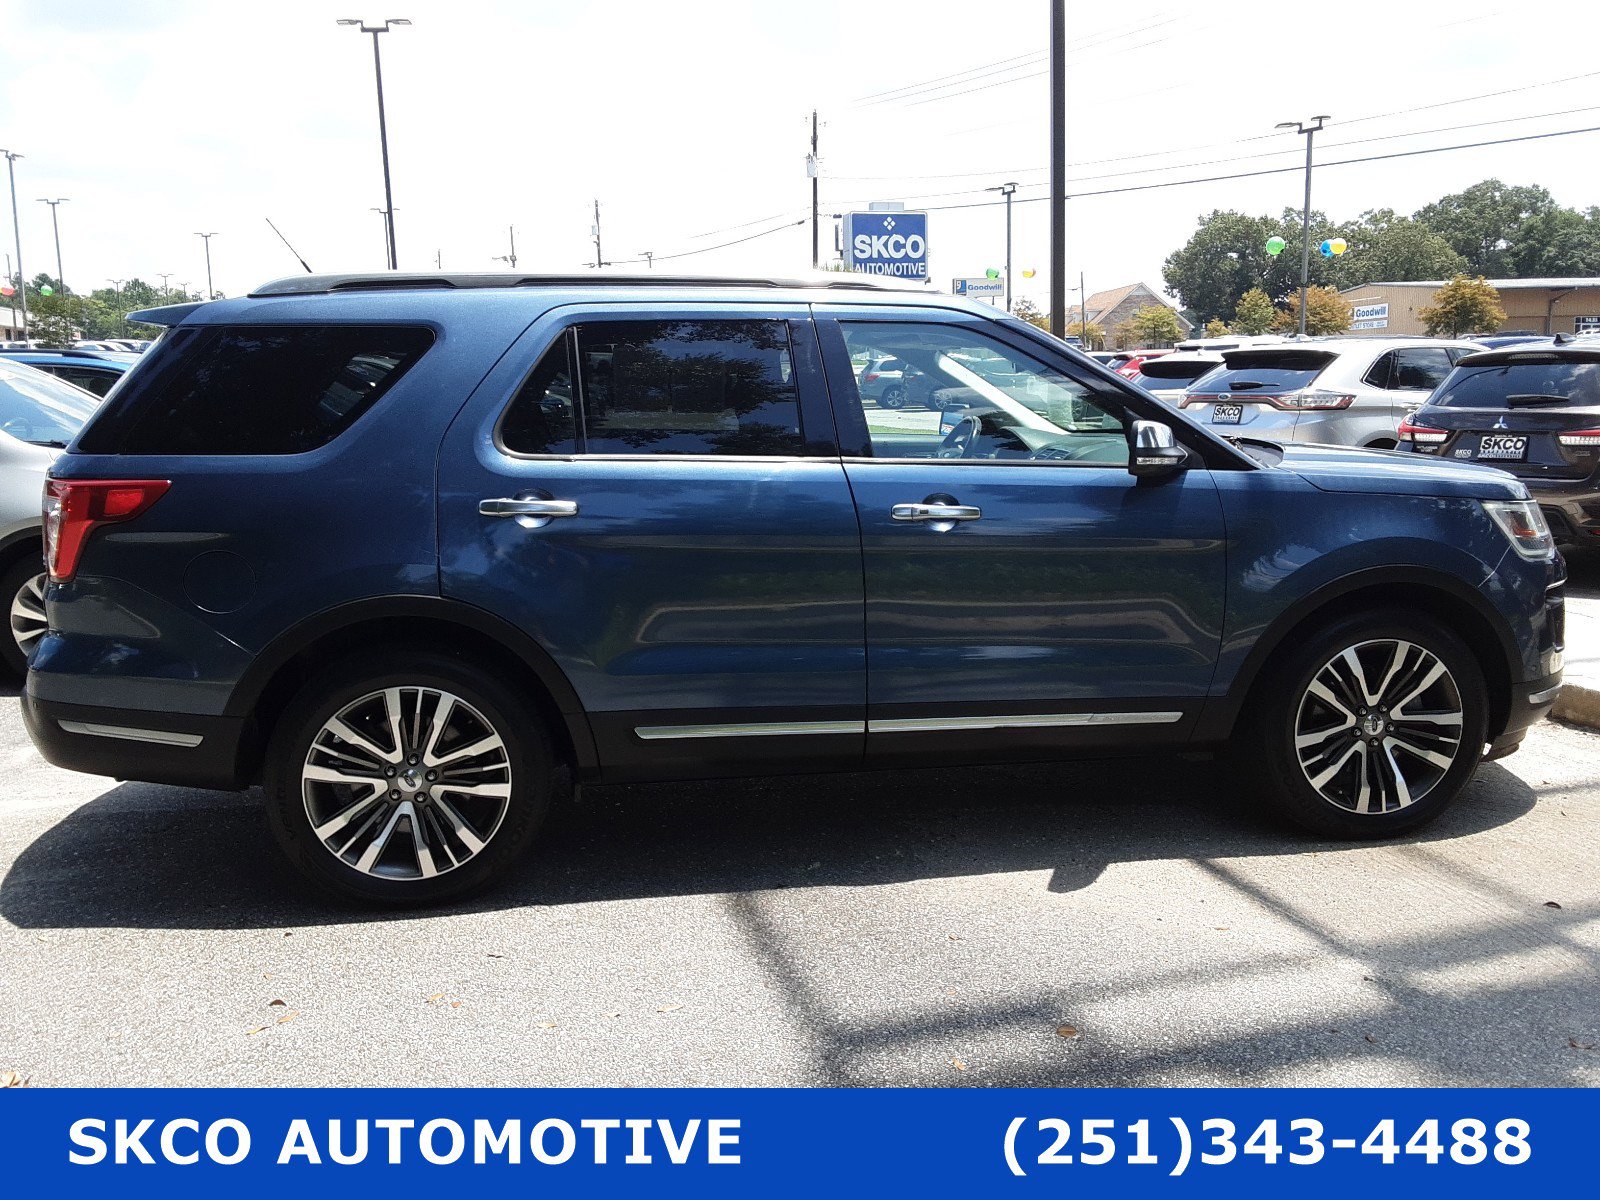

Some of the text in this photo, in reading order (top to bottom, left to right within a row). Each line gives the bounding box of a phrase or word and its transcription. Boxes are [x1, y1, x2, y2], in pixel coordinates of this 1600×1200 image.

[854, 234, 925, 259] SKCO
[855, 262, 925, 275] AUTOMOTIVE
[967, 283, 1002, 291] Goodwill
[1356, 306, 1386, 317] Goodwill
[1214, 407, 1240, 416] SKCO
[1481, 438, 1526, 450] SKCO
